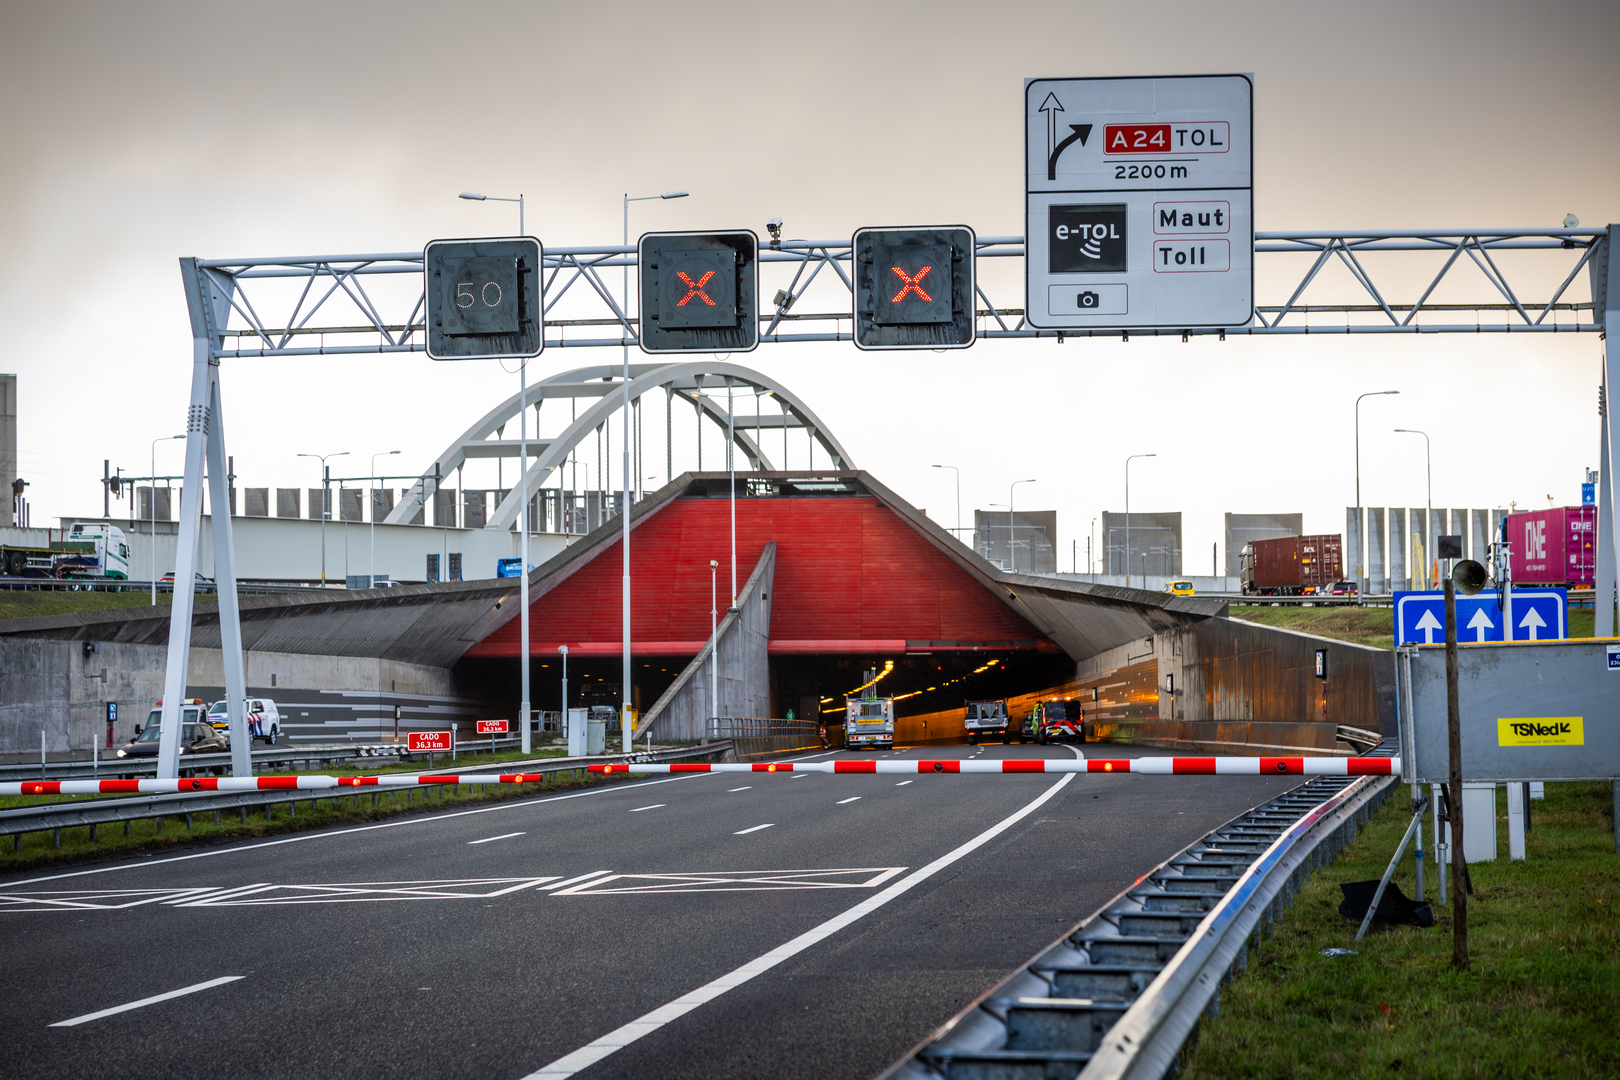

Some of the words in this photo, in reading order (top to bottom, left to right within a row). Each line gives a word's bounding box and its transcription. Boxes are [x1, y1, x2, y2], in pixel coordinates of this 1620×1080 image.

[1175, 128, 1223, 147] TOL
[1115, 165, 1166, 179] 2200
[1170, 165, 1188, 179] m
[1160, 208, 1224, 227] Maut
[1055, 223, 1120, 240] e-TOL
[1159, 246, 1205, 265] Toll
[456, 282, 502, 308] 50
[1570, 521, 1592, 530] ONE
[1525, 519, 1546, 560] ONE
[1303, 545, 1315, 553] tex
[1510, 722, 1559, 736] TSNed
